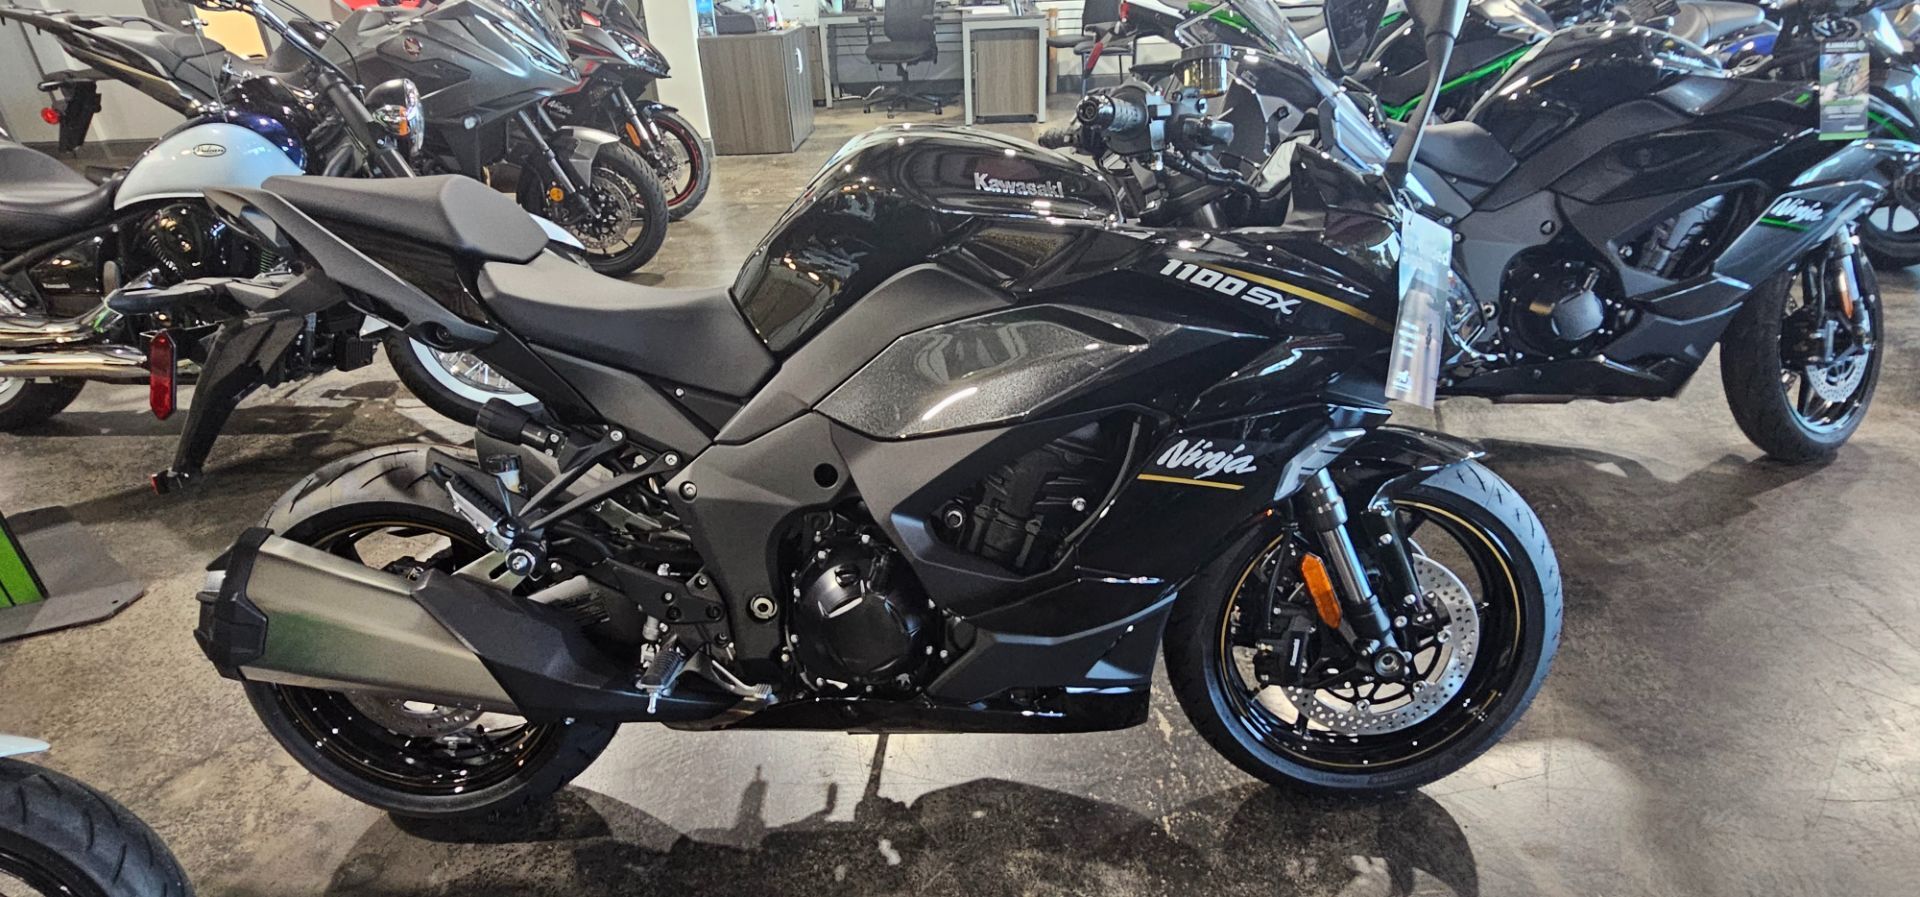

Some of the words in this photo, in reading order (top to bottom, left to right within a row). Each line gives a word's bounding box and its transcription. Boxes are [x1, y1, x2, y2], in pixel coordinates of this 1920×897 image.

[974, 172, 1065, 198] Kawasaki
[1770, 197, 1823, 224] Ninja
[1156, 439, 1257, 480] Ninja
